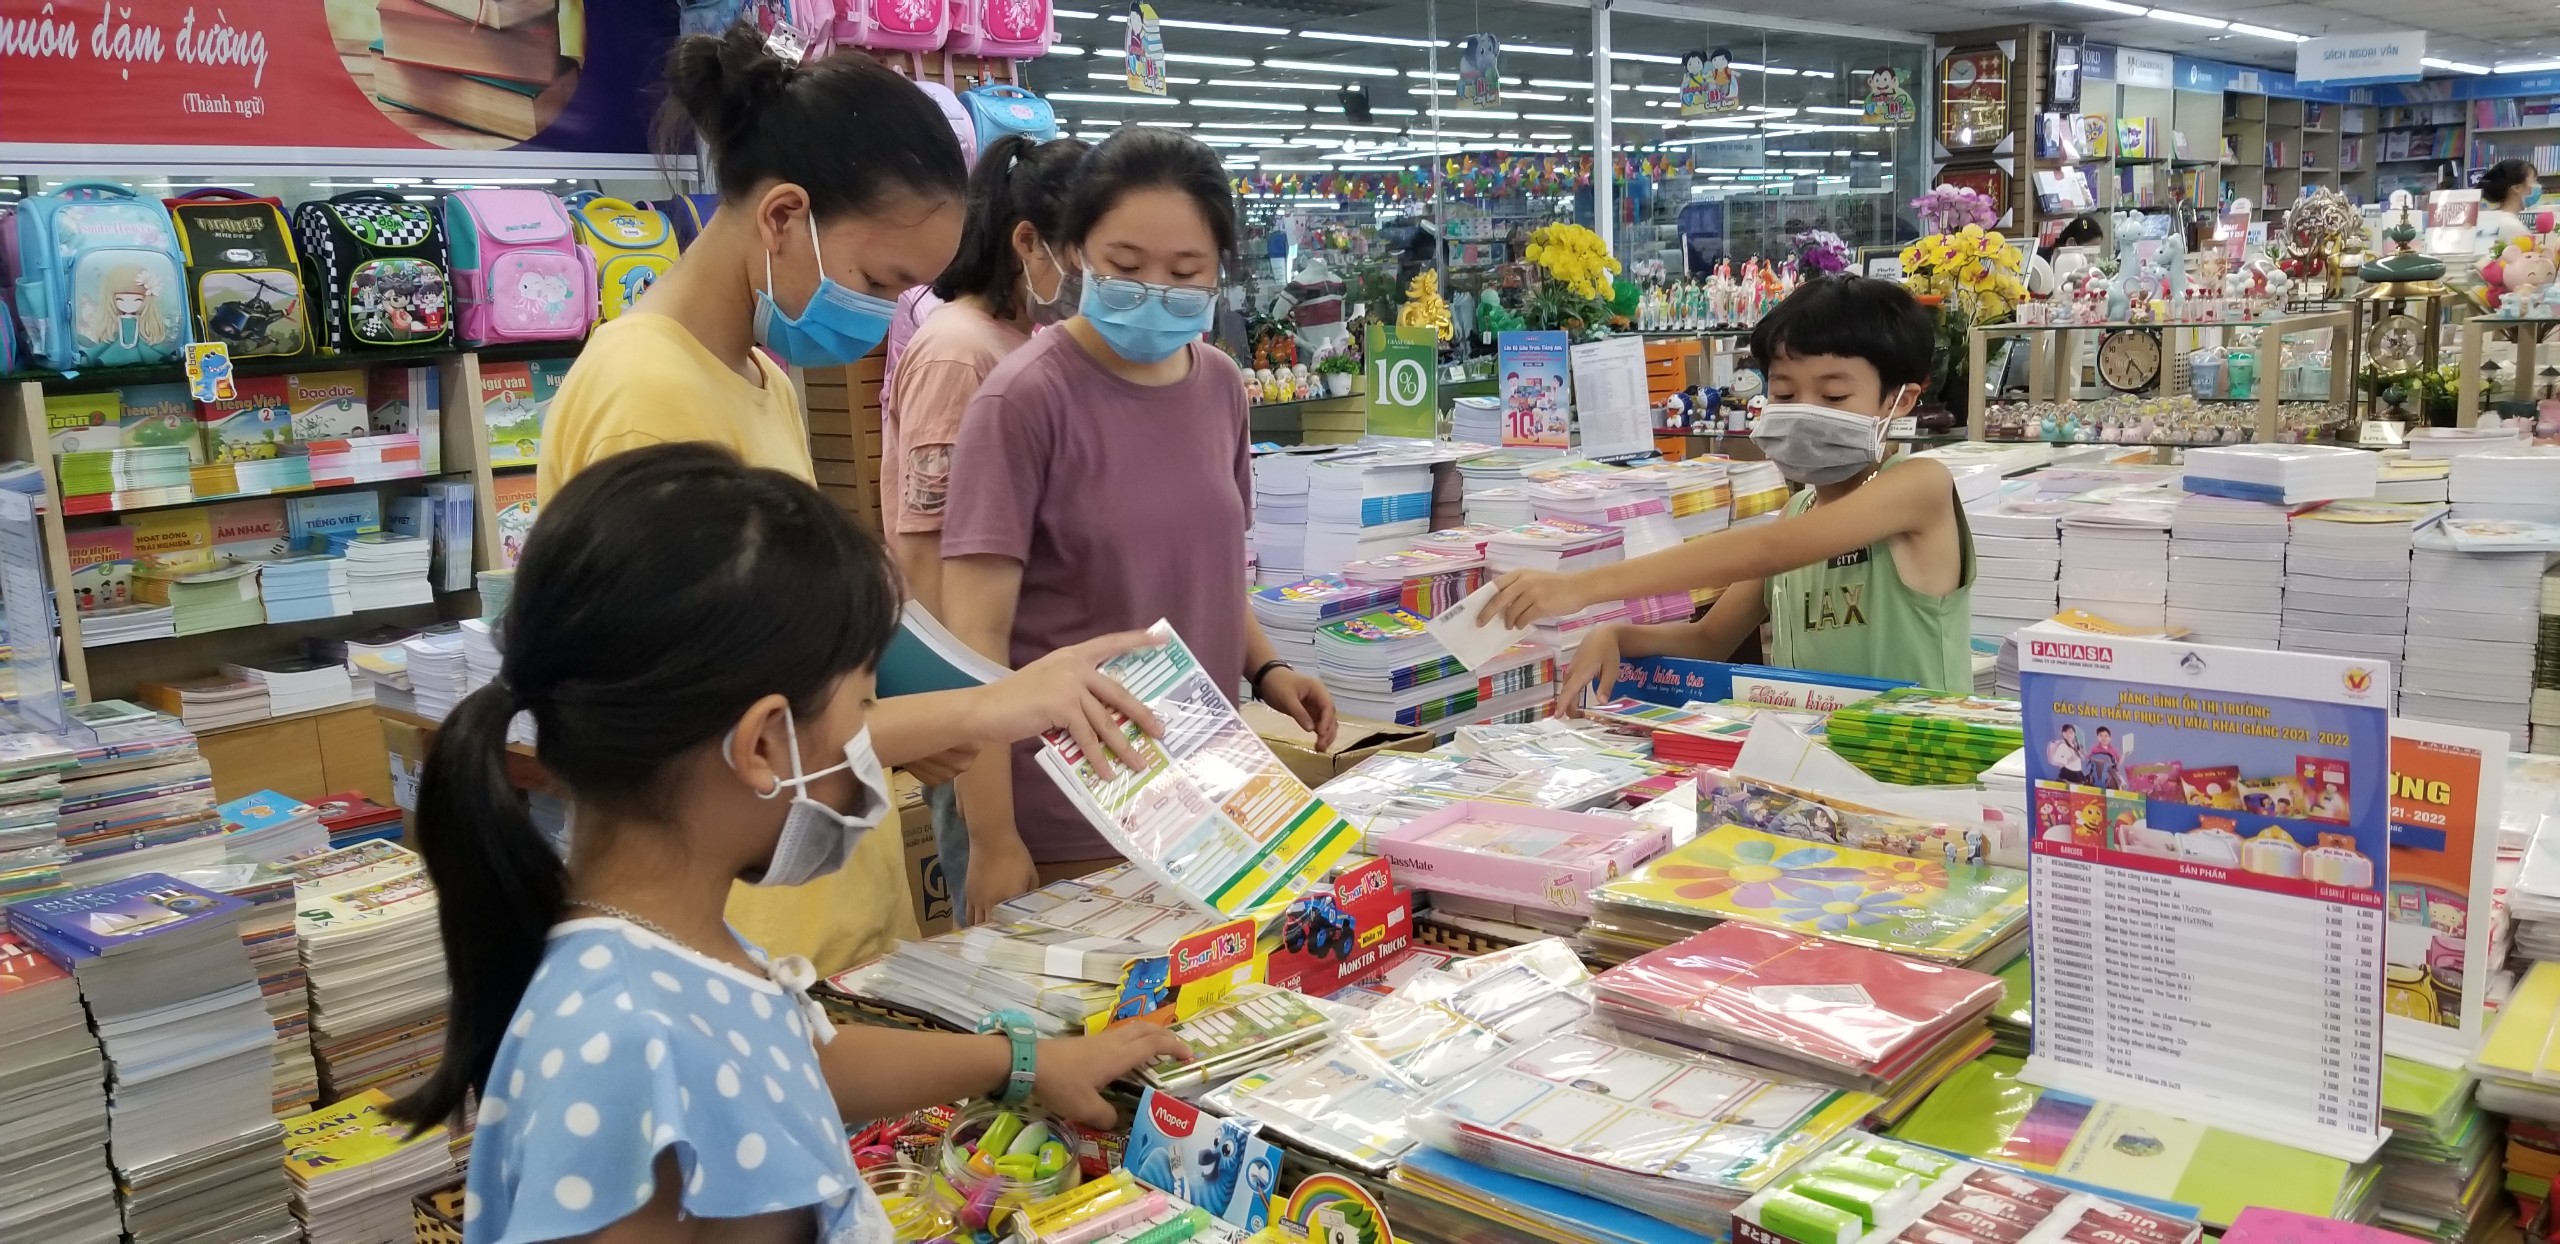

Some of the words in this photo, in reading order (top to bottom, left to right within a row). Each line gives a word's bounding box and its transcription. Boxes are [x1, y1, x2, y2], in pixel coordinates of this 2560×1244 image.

[91, 1, 165, 80] dặm
[175, 6, 268, 89] đường
[182, 93, 231, 114] (Thành
[235, 95, 265, 118] ngữ)
[504, 375, 527, 389] văn
[1374, 358, 1427, 407] 10
[252, 393, 282, 410] Việt
[299, 386, 327, 402] Đạo
[328, 383, 354, 397] đức
[504, 391, 512, 403] 6
[341, 400, 349, 411] 2
[263, 410, 271, 421] 2
[363, 510, 372, 521] 2
[523, 502, 530, 513] 6
[275, 520, 284, 531] 2
[306, 515, 337, 529] TIẾNG
[339, 511, 362, 528] VIỆT
[194, 532, 203, 545] 2
[217, 524, 236, 539] ÂM
[237, 523, 272, 538] NHẠC
[1837, 552, 1858, 566] CITY
[102, 564, 110, 574] 2
[1804, 582, 1868, 633] LAX
[2032, 642, 2112, 663] FAHASA
[1653, 665, 1680, 687] kiểm
[1686, 671, 1704, 688] tra
[2119, 687, 2150, 706] HÀNG
[2153, 690, 2179, 709] BÌNH
[2183, 693, 2198, 712] ỔN
[2201, 700, 2219, 716] THỊ
[2222, 701, 2271, 719] TRƯỜNG
[2053, 699, 2075, 715] CÁC
[2077, 702, 2099, 718] SẢN
[2101, 703, 2131, 721] PHẨM
[2134, 710, 2164, 727] PHỤC
[2167, 713, 2181, 729] VỤ
[2184, 712, 2209, 731] MÙA
[2212, 718, 2240, 735] KHAI
[2242, 720, 2279, 738] GIẢNG
[2282, 727, 2310, 743] 2021
[2318, 731, 2350, 747] 2022
[2414, 810, 2446, 825] 2022
[2179, 863, 2198, 876] SẢN
[2199, 864, 2227, 881] PHẨM
[1338, 951, 1375, 978] MONSTER
[1378, 935, 1407, 958] TRUCKS
[1155, 1107, 1188, 1130] Maped
[1950, 1211, 1997, 1231] Ain
